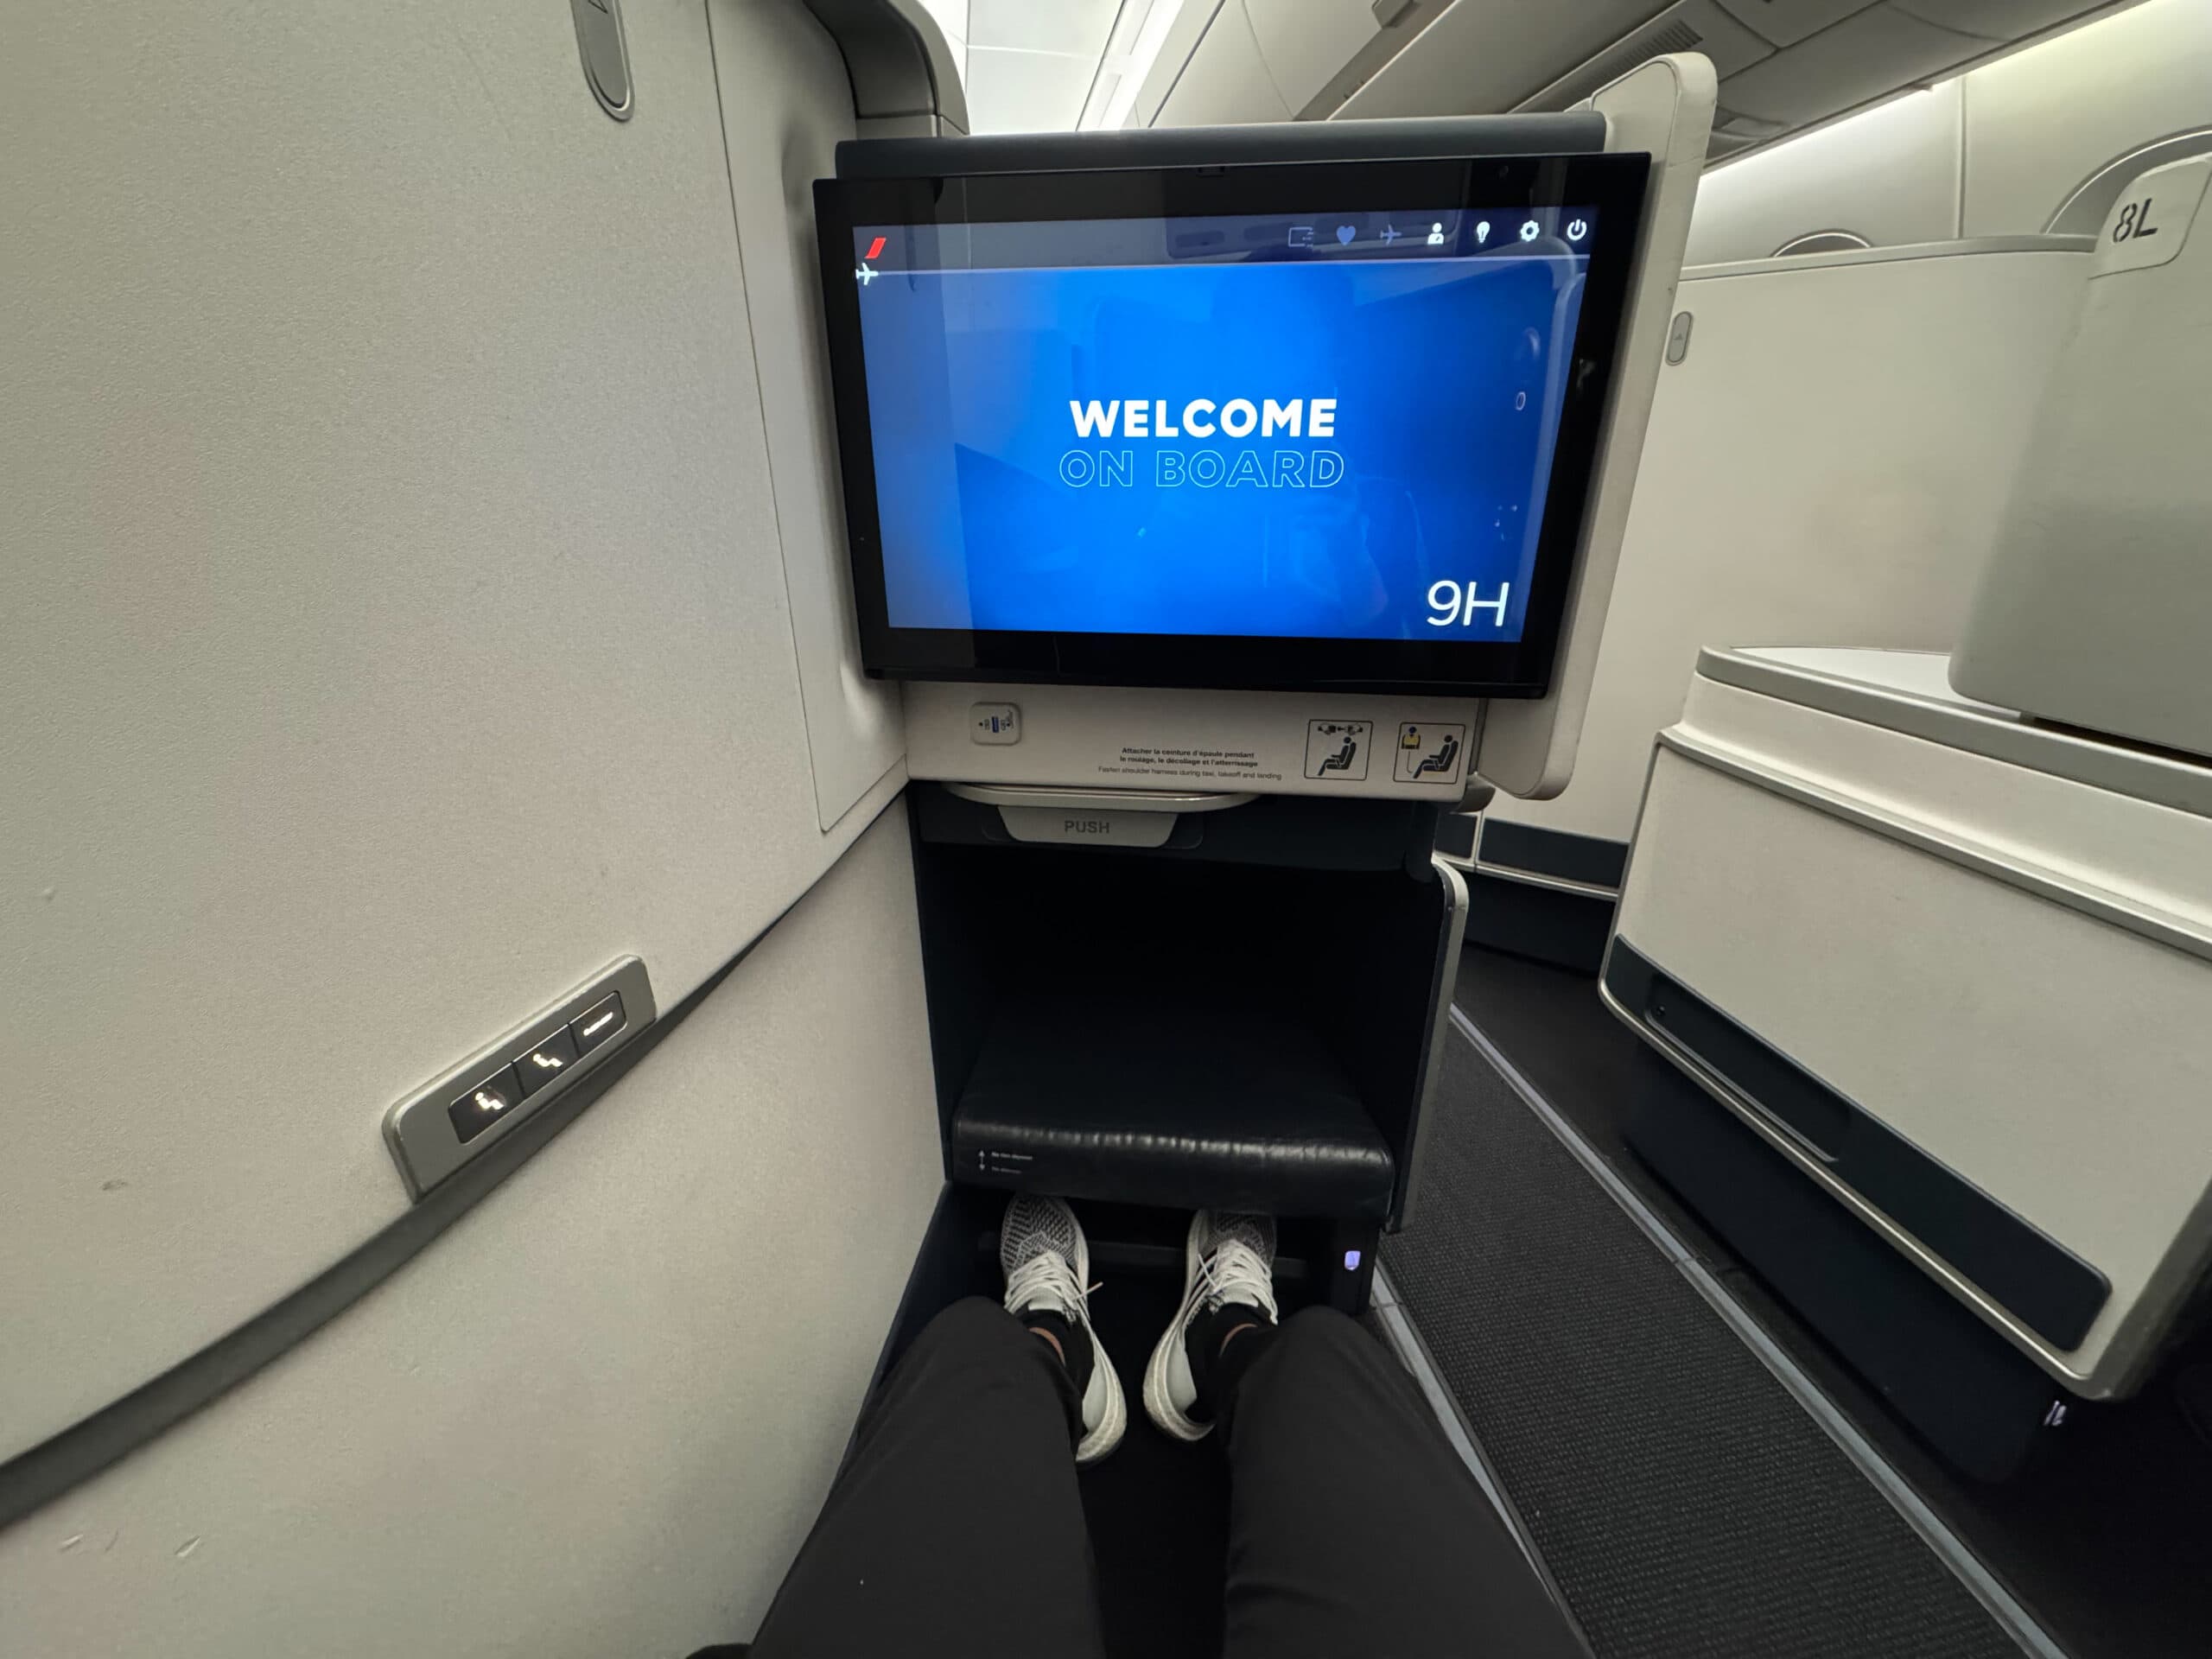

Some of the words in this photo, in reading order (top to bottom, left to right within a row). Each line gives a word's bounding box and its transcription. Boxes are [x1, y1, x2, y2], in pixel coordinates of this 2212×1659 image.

[2113, 197, 2158, 243] 8L
[1069, 398, 1338, 438] WELCOME
[1059, 449, 1133, 488] ON
[1155, 449, 1344, 488] BOARD
[1427, 580, 1510, 627] 9H
[1179, 769, 1201, 778] during
[1257, 772, 1282, 781] landing
[1064, 821, 1109, 834] PUSH
